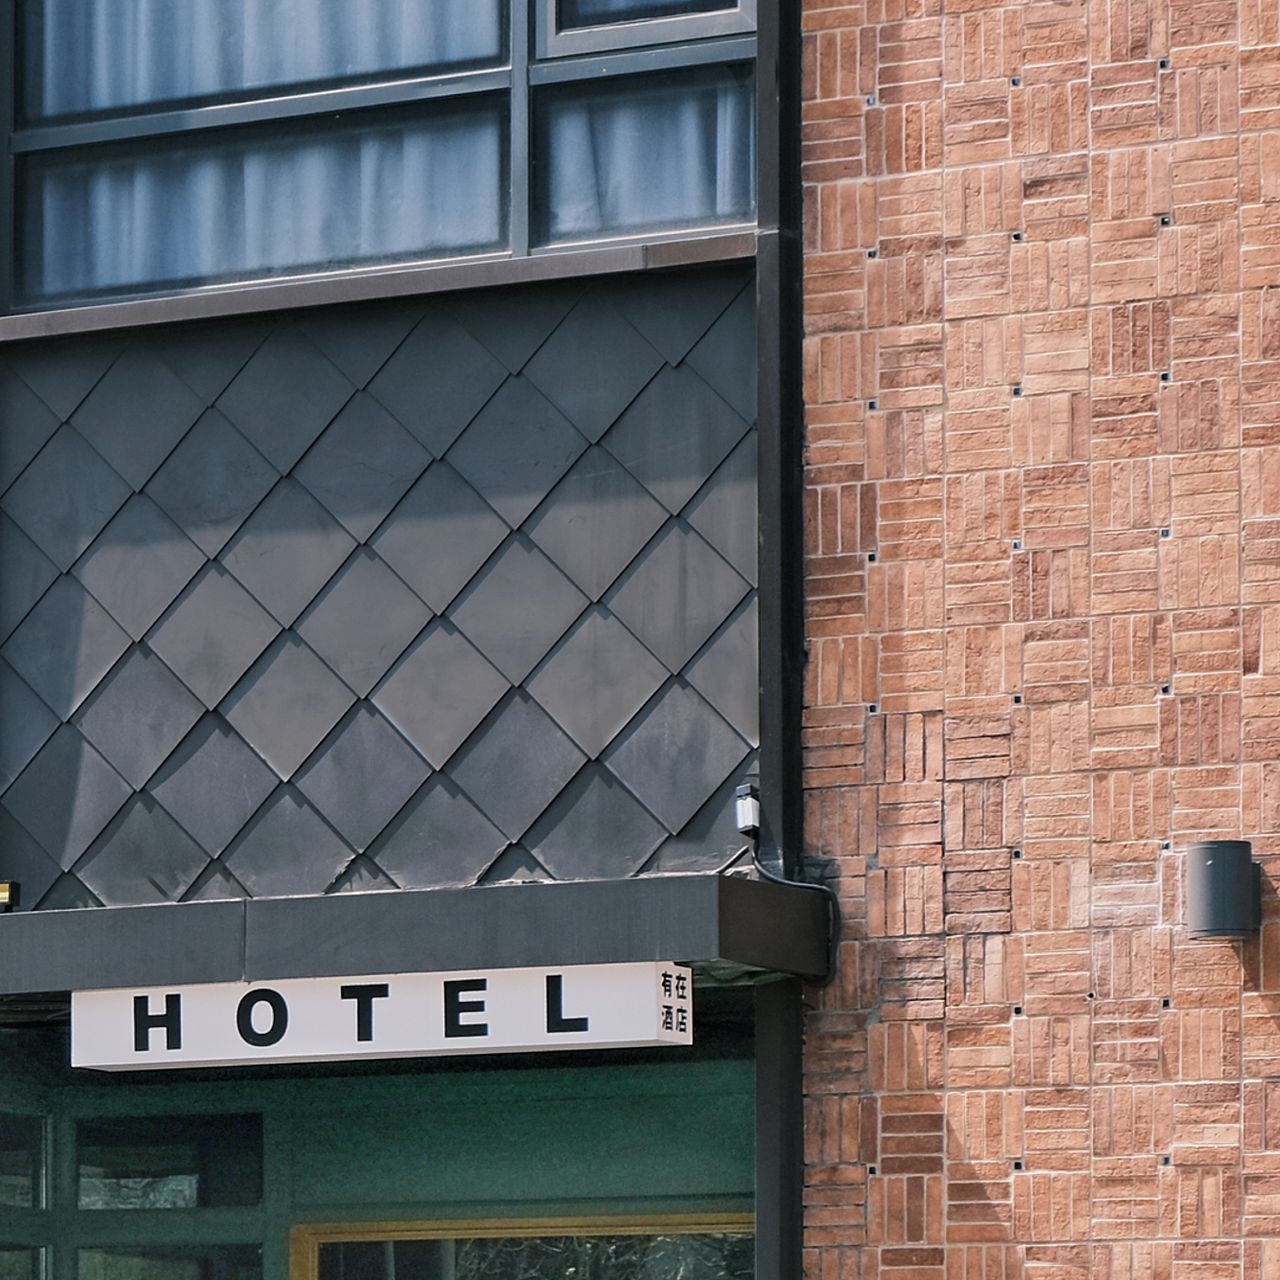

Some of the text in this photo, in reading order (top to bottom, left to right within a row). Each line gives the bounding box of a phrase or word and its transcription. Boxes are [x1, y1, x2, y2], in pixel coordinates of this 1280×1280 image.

[661, 970, 688, 999] 有在
[133, 974, 589, 1052] HOTEL
[661, 1004, 688, 1033] 酒店
